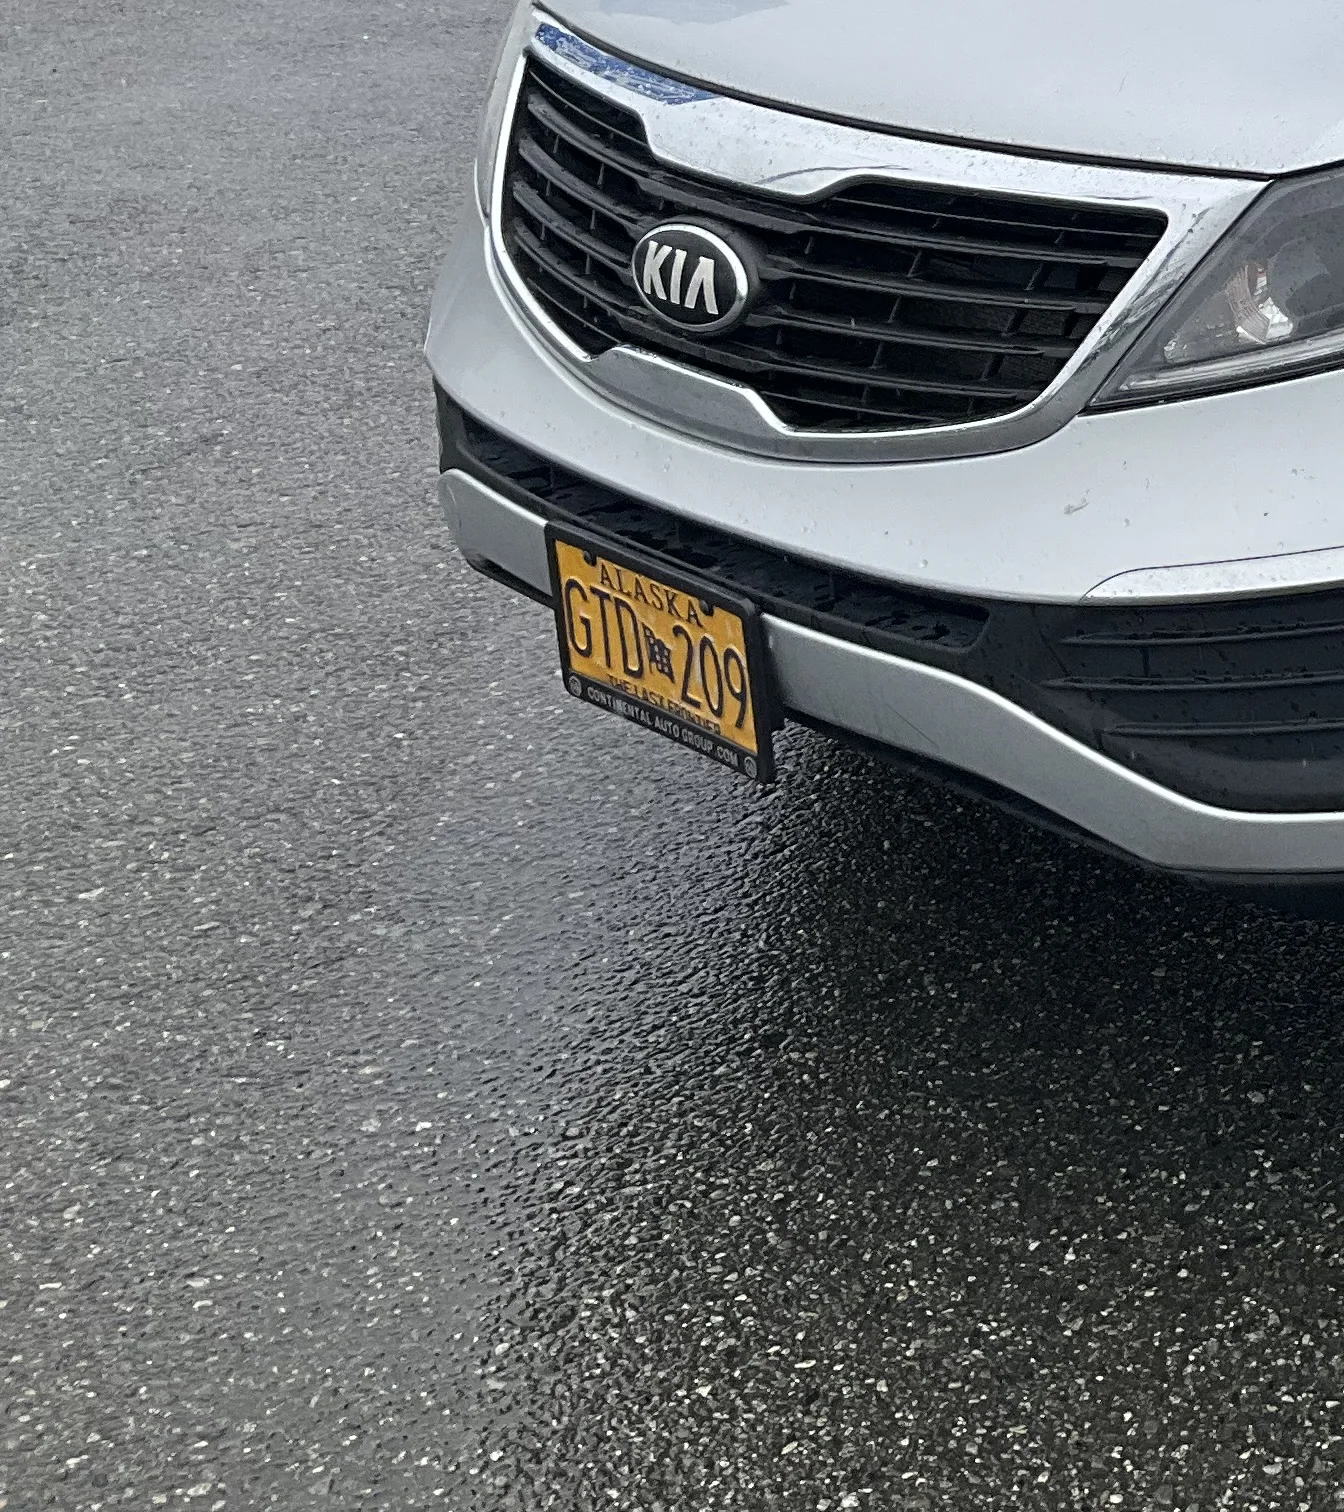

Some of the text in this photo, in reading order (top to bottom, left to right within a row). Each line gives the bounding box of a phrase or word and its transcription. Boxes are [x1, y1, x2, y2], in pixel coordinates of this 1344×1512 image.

[642, 240, 719, 315] KIA
[600, 563, 704, 628] ALASKA
[564, 578, 748, 729] GTD 209
[654, 715, 680, 738] AUTO
